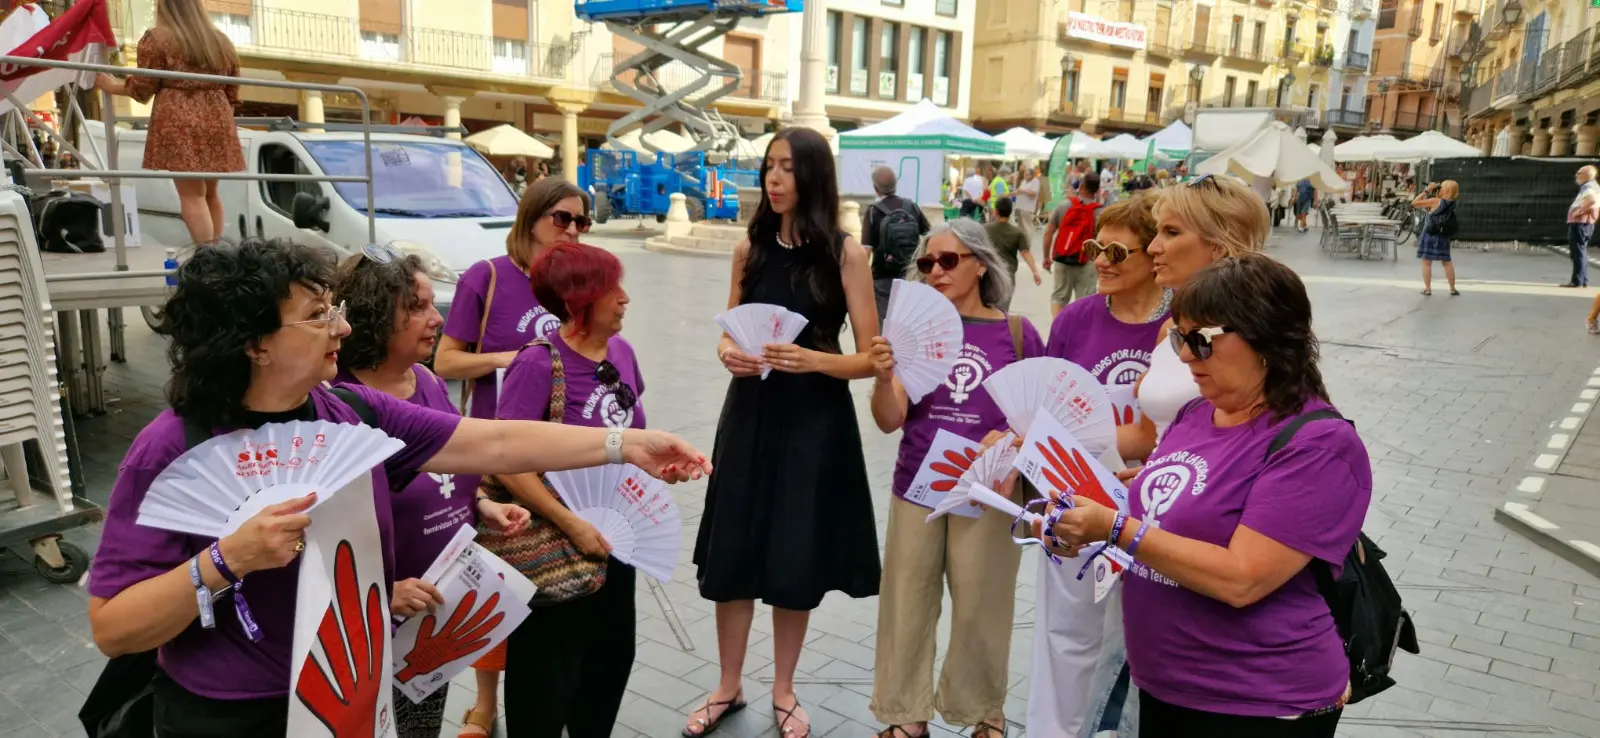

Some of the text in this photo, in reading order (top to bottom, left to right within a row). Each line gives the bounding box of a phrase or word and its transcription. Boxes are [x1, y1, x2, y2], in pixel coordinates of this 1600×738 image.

[1111, 349, 1129, 362] POR
[1130, 349, 1143, 359] LA
[1138, 564, 1149, 579] de
